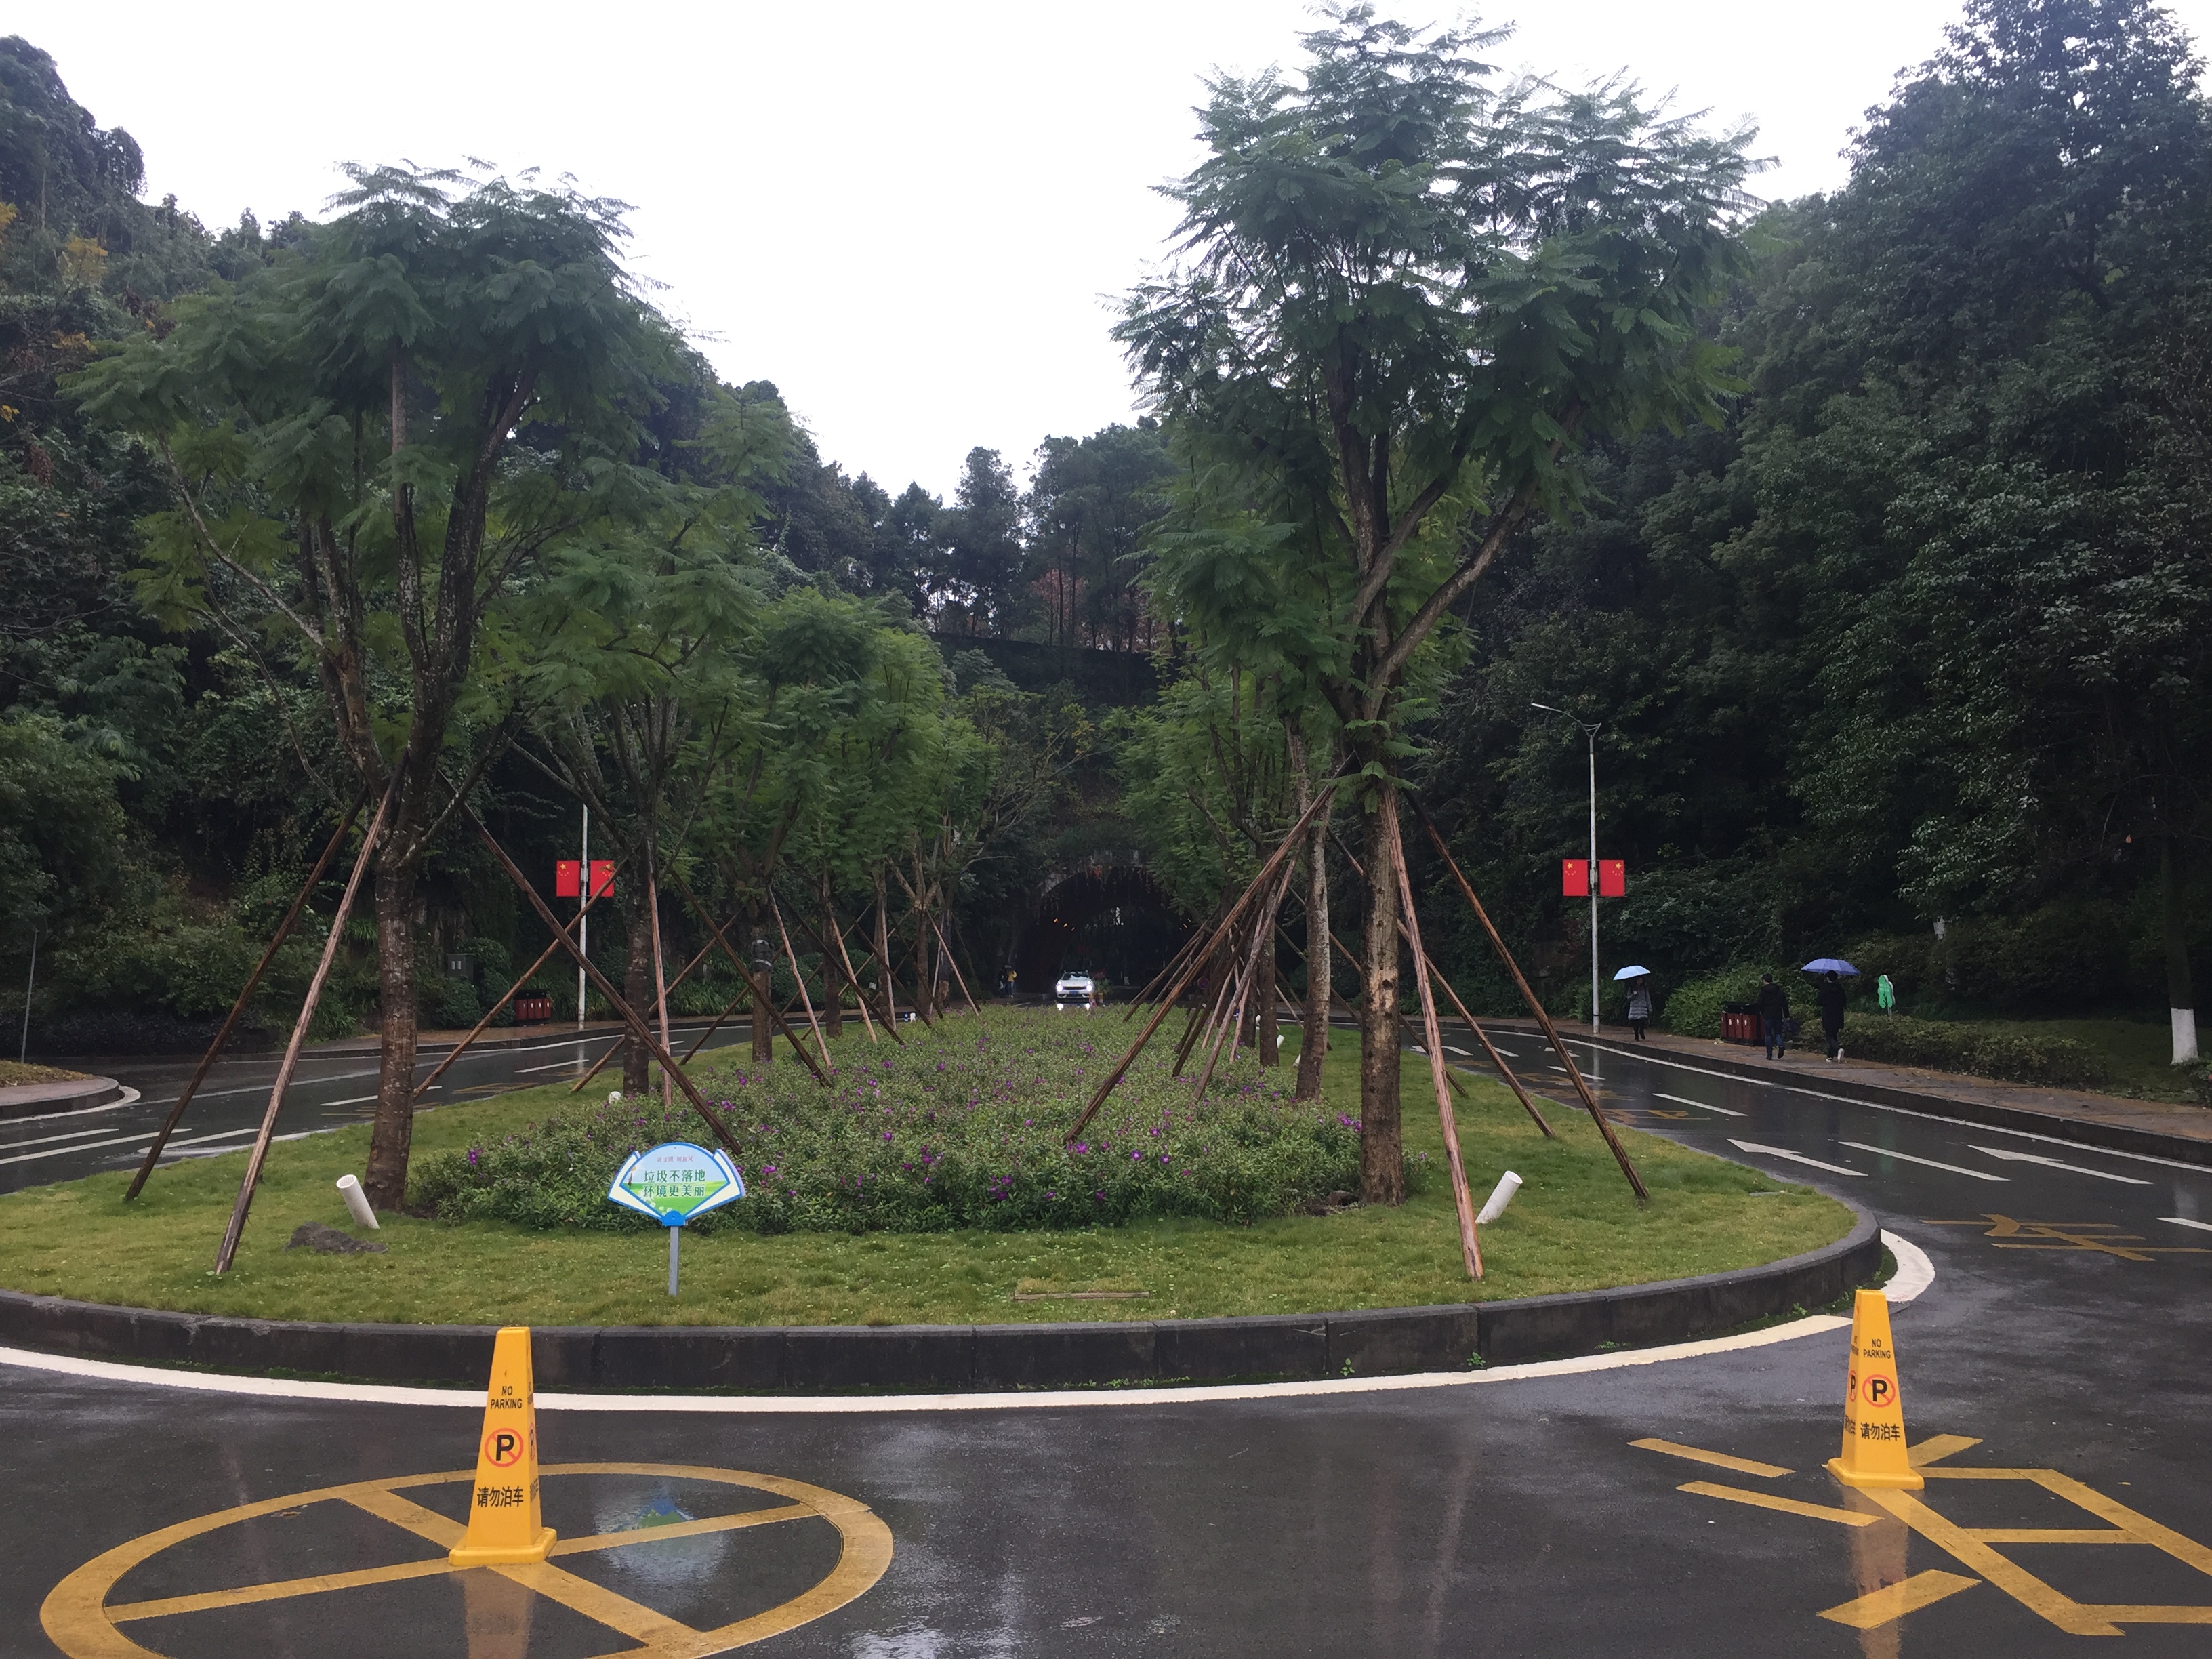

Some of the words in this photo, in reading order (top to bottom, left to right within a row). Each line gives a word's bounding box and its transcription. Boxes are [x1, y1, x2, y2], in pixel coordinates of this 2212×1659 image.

[644, 1169, 705, 1183] 垃圾不落地
[643, 1184, 705, 1197] 环境更美丽
[1871, 1338, 1881, 1348] NO
[1863, 1349, 1891, 1359] PARKING
[501, 1385, 513, 1396] NO
[1872, 1379, 1887, 1402] P
[490, 1398, 523, 1409] PARKING
[1860, 1422, 1900, 1441] 请勿泊车
[496, 1434, 514, 1461] P
[477, 1486, 524, 1507] 请勿泊车
